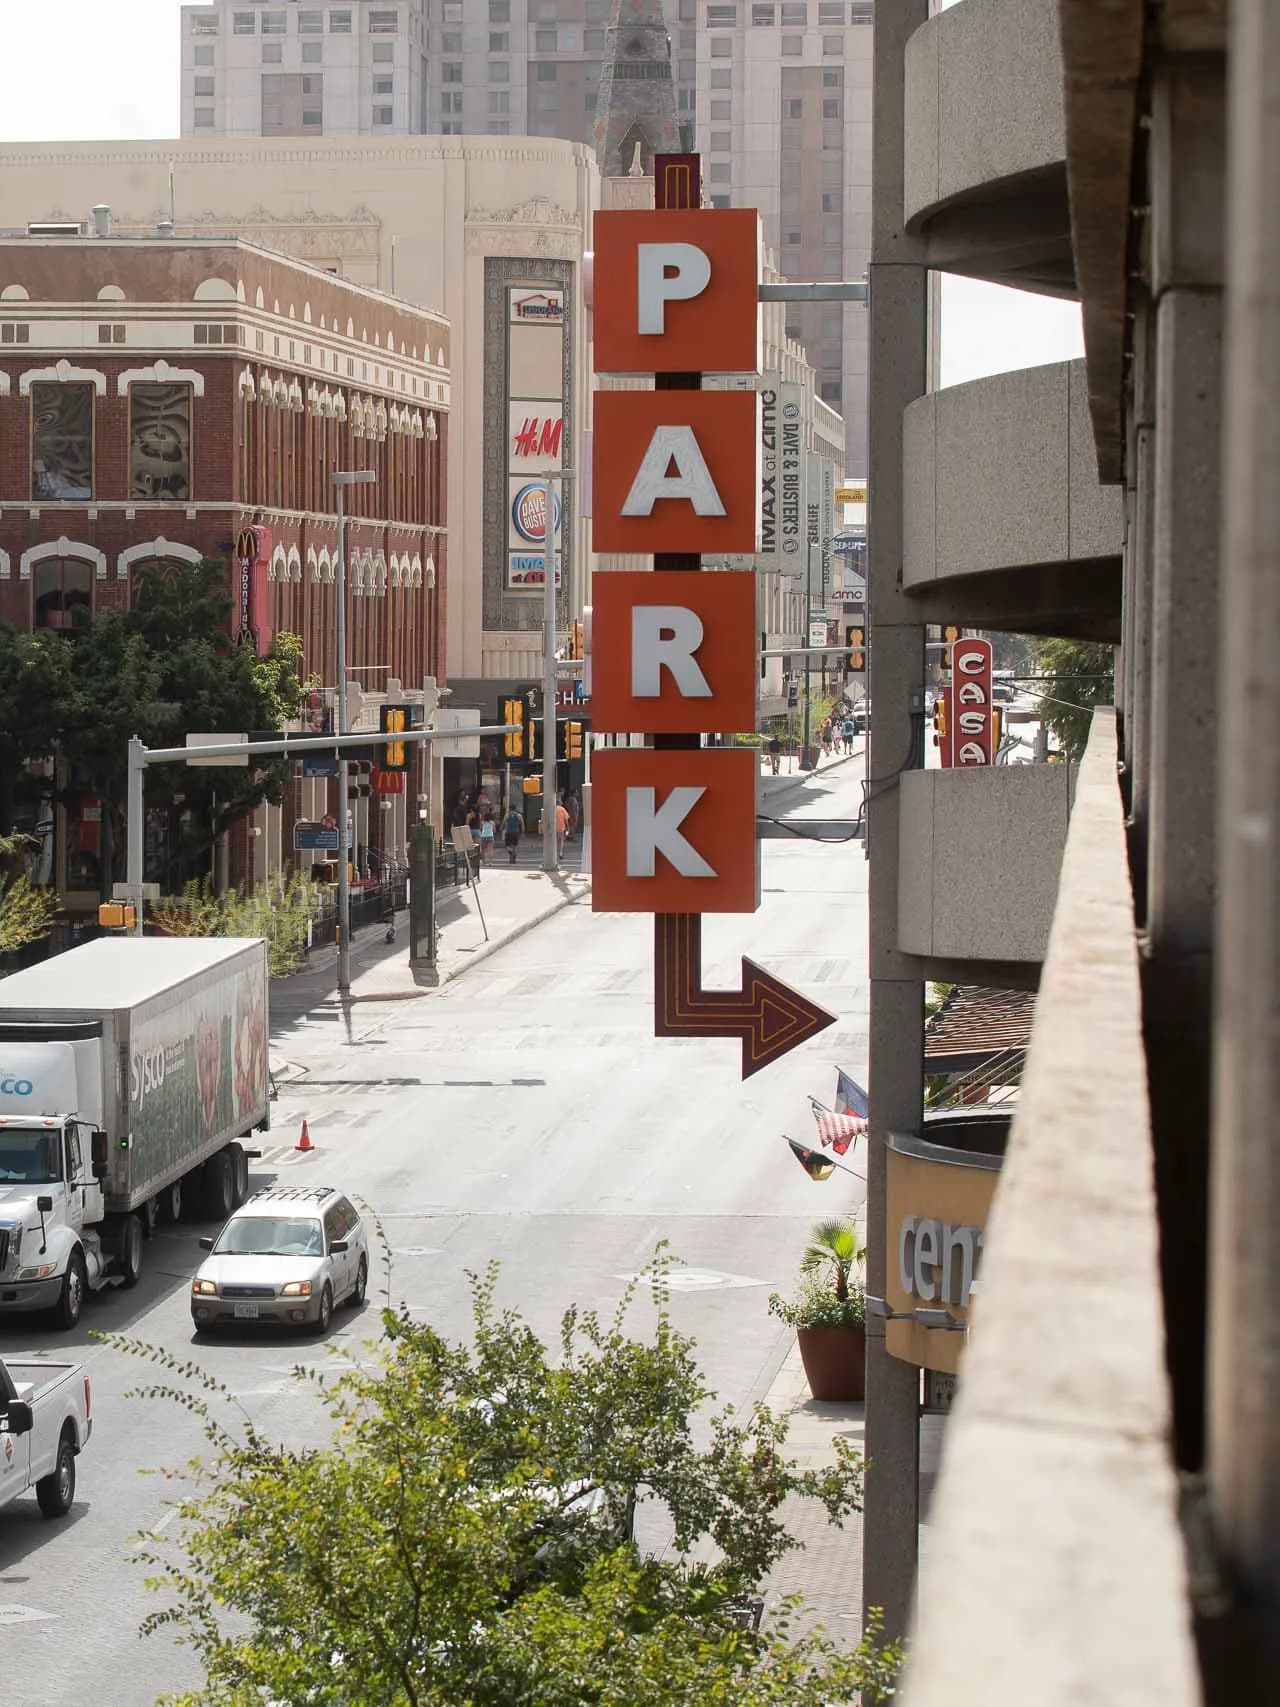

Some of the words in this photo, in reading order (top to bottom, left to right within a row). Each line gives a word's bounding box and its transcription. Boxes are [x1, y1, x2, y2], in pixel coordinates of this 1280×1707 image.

[513, 416, 564, 458] H&M
[764, 455, 776, 471] at
[783, 423, 799, 456] DAVE
[762, 476, 776, 553] IMAX
[621, 242, 728, 877] PARK
[832, 590, 863, 600] amc
[958, 652, 986, 764] CASA
[899, 1214, 984, 1307] cen
